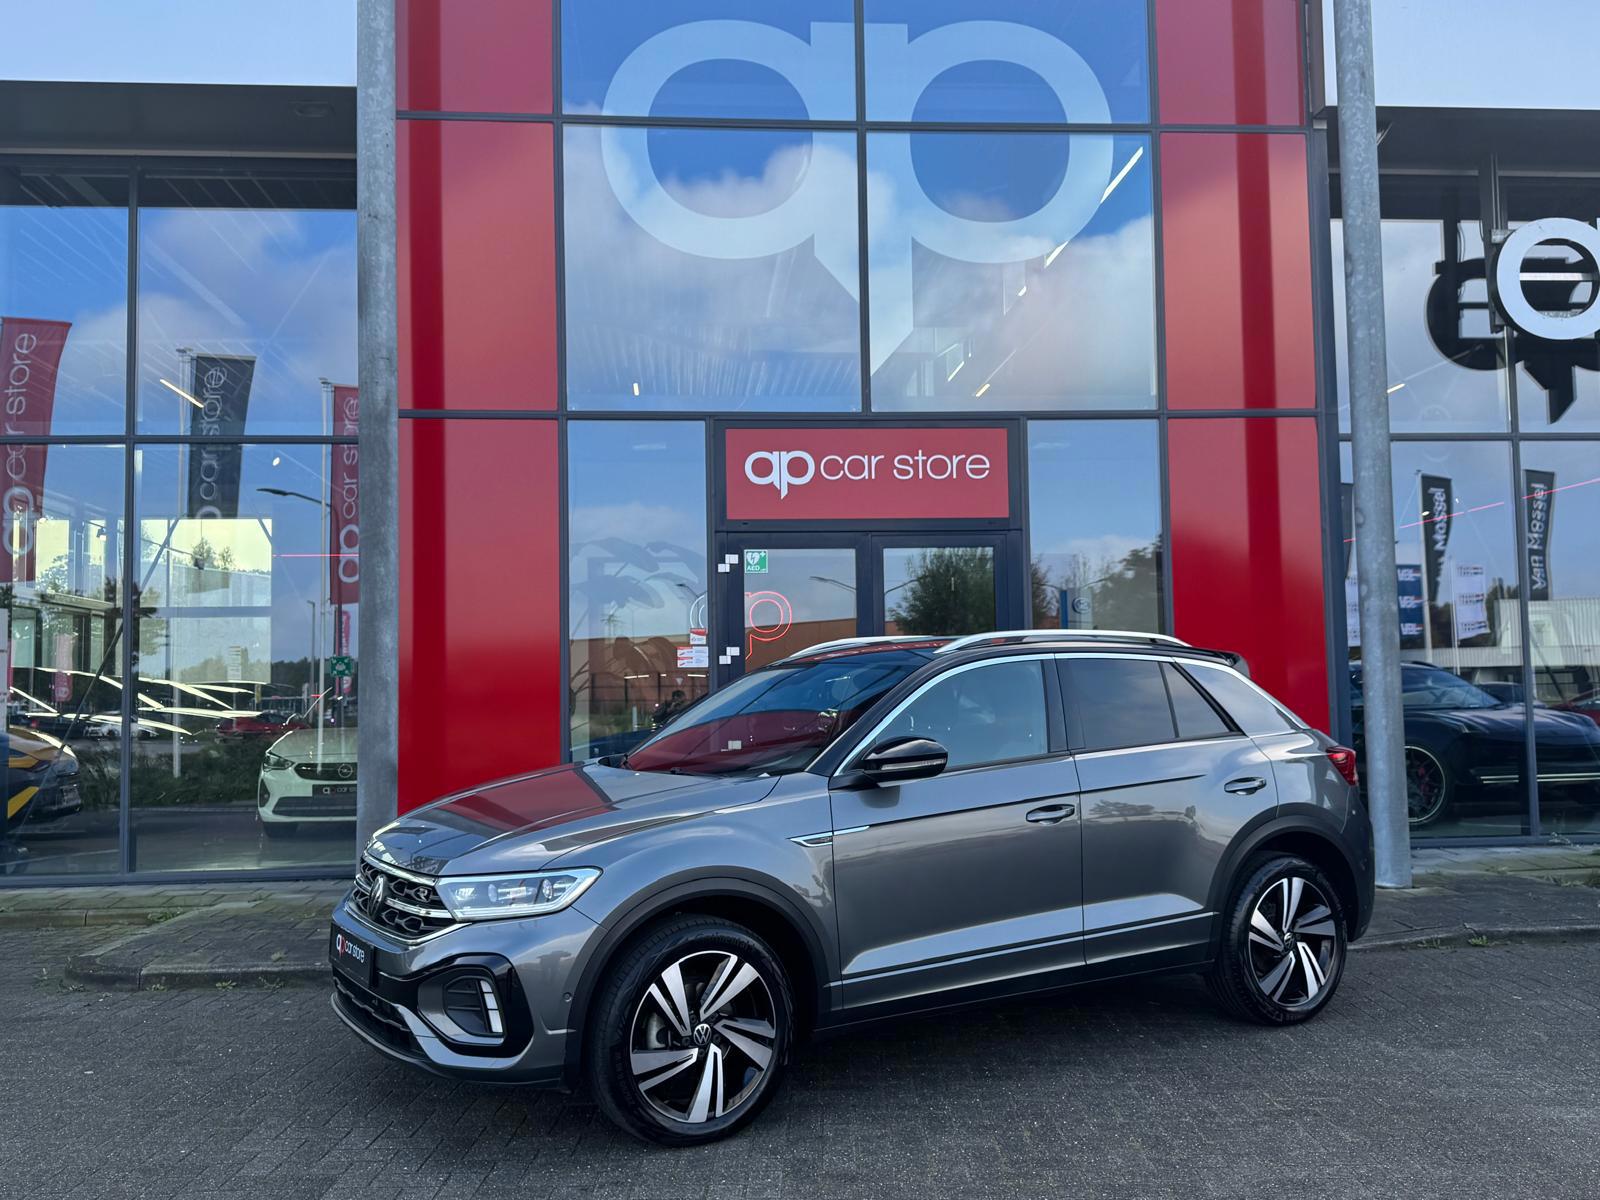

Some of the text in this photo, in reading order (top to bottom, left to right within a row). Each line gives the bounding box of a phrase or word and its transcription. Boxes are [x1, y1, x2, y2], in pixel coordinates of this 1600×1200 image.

[601, 19, 1114, 377] ap
[4, 332, 37, 415] store
[343, 472, 358, 519] car
[744, 449, 990, 500] ap car store
[352, 945, 365, 964] store
